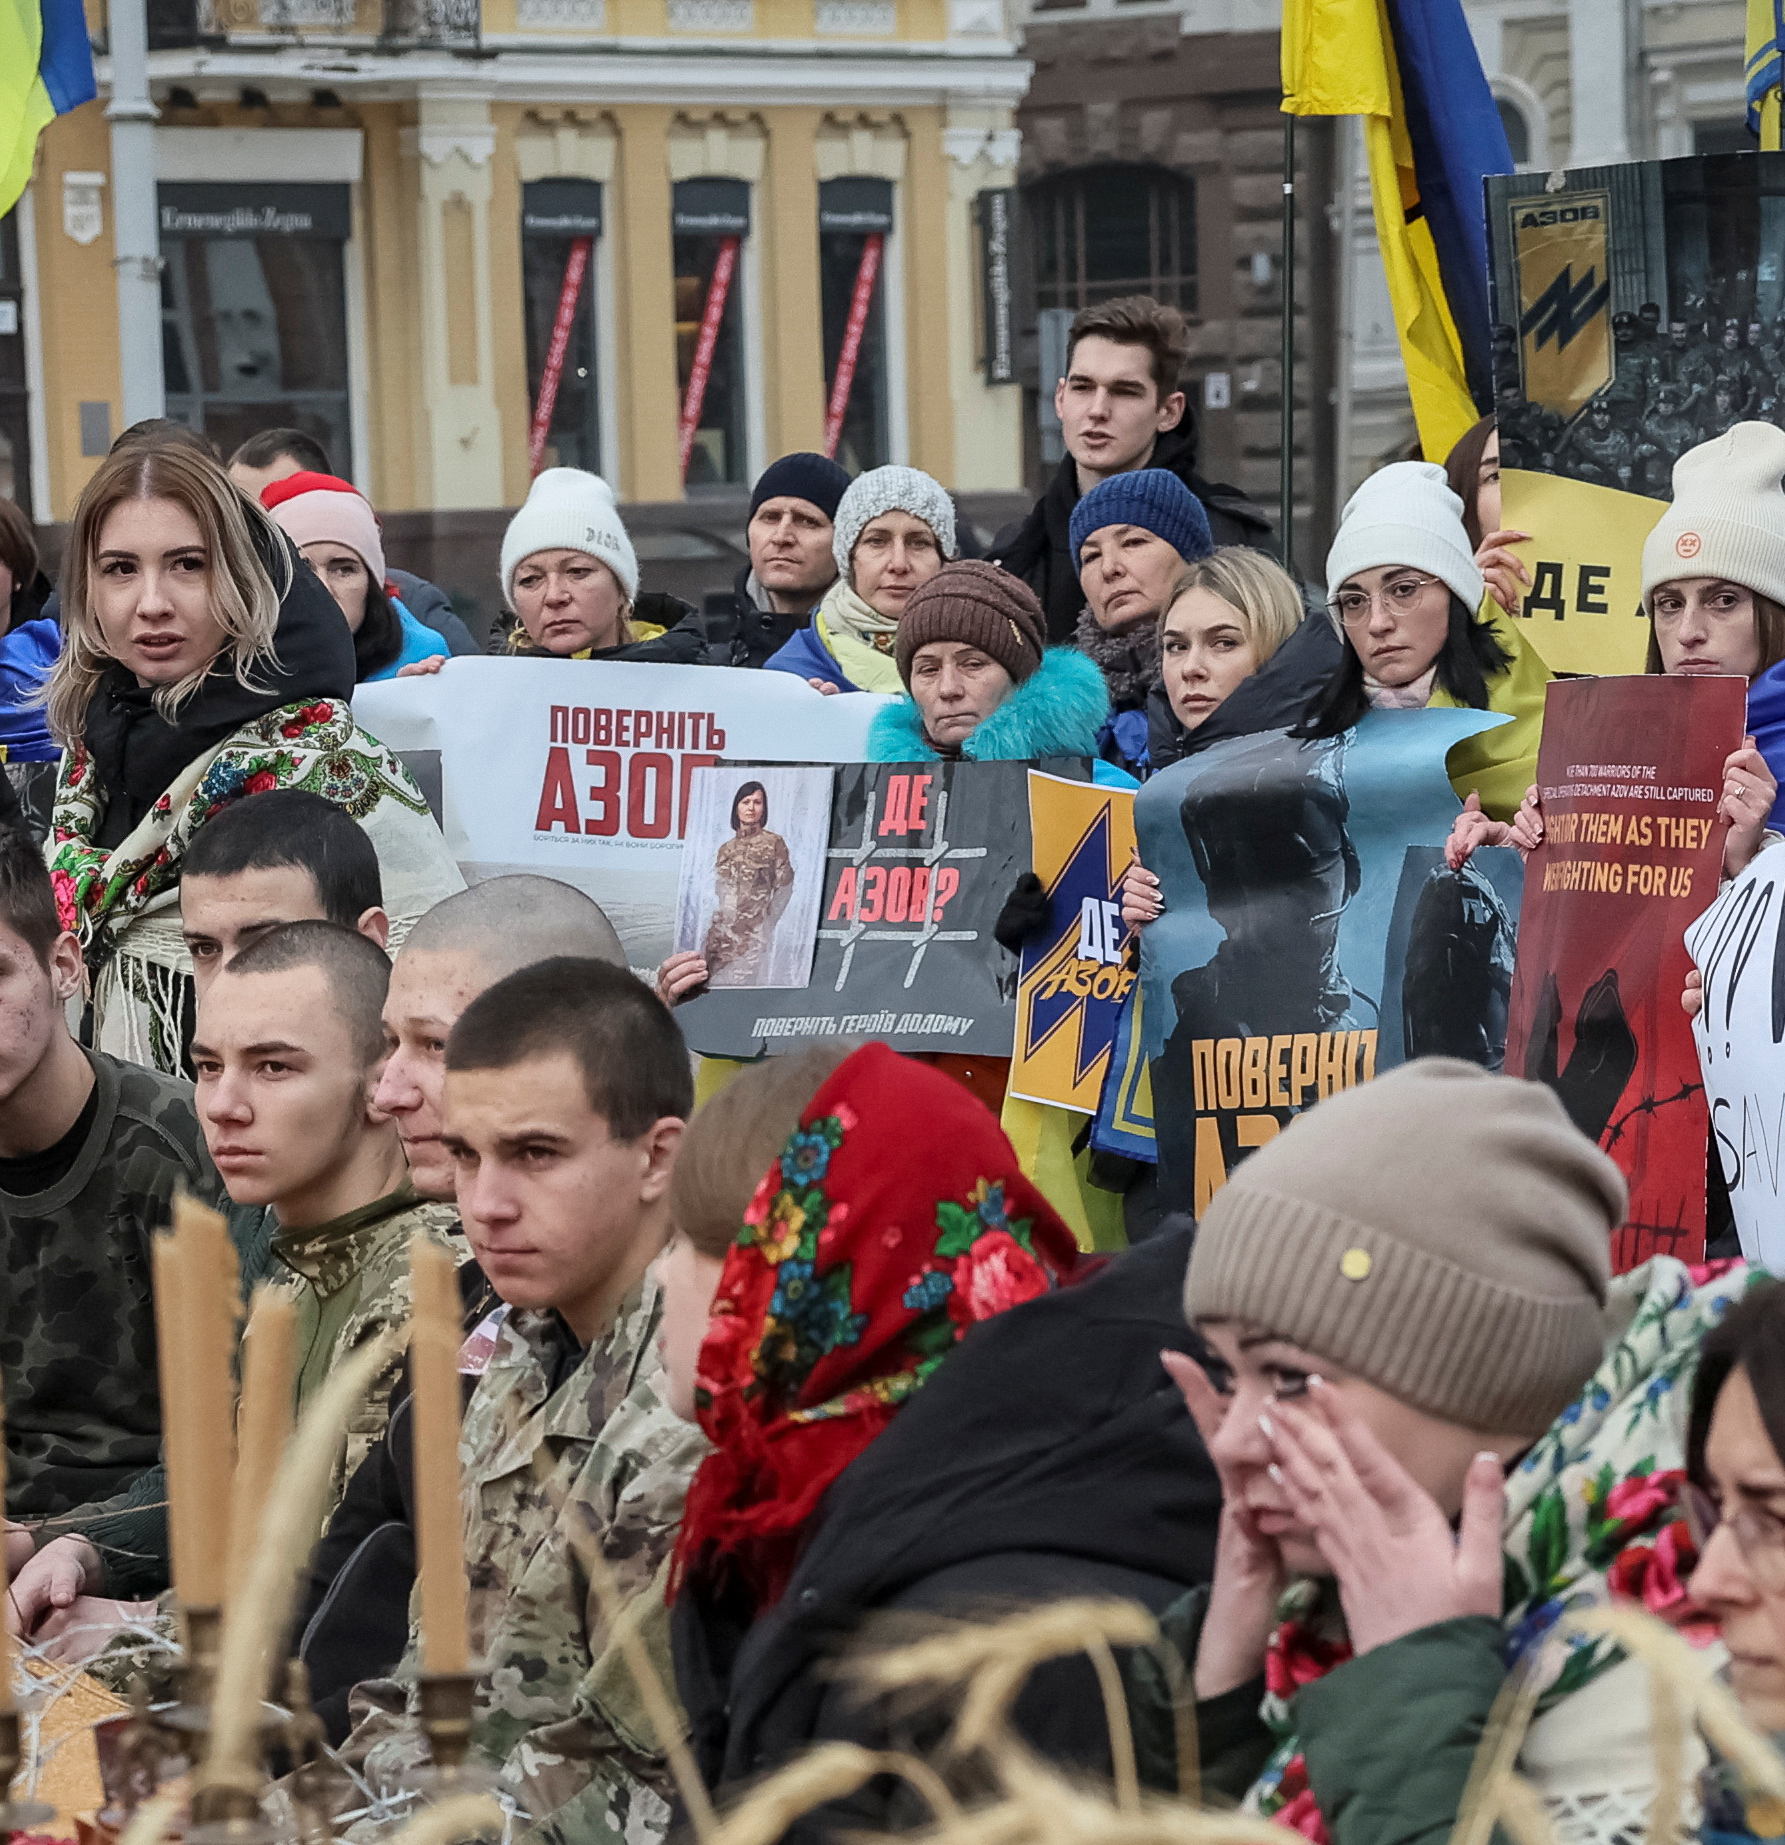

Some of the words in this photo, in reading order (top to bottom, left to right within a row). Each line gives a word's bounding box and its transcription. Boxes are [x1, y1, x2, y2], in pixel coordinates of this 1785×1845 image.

[1522, 561, 1611, 621] ДЕ
[550, 705, 726, 751] ПОВЕРНІТЬ
[1628, 785, 1643, 799] ARE
[1643, 786, 1665, 801] STILL
[1667, 787, 1714, 803] CAPTURED
[1631, 766, 1642, 779] OF
[1642, 766, 1657, 780] THE
[878, 774, 933, 836] ДЕ
[1579, 812, 1624, 845] THEM
[1624, 815, 1653, 847] AS
[1657, 816, 1713, 850] THEY
[827, 866, 960, 923] АЗОВ?
[1625, 864, 1667, 897] FOR
[1669, 866, 1694, 898] US
[1078, 896, 1122, 965] ДЕ
[751, 1016, 836, 1038] ПОВЕРНІТЬ
[838, 1009, 897, 1035] ГЕРОЇВ
[894, 1012, 975, 1037] ДОДОМУ
